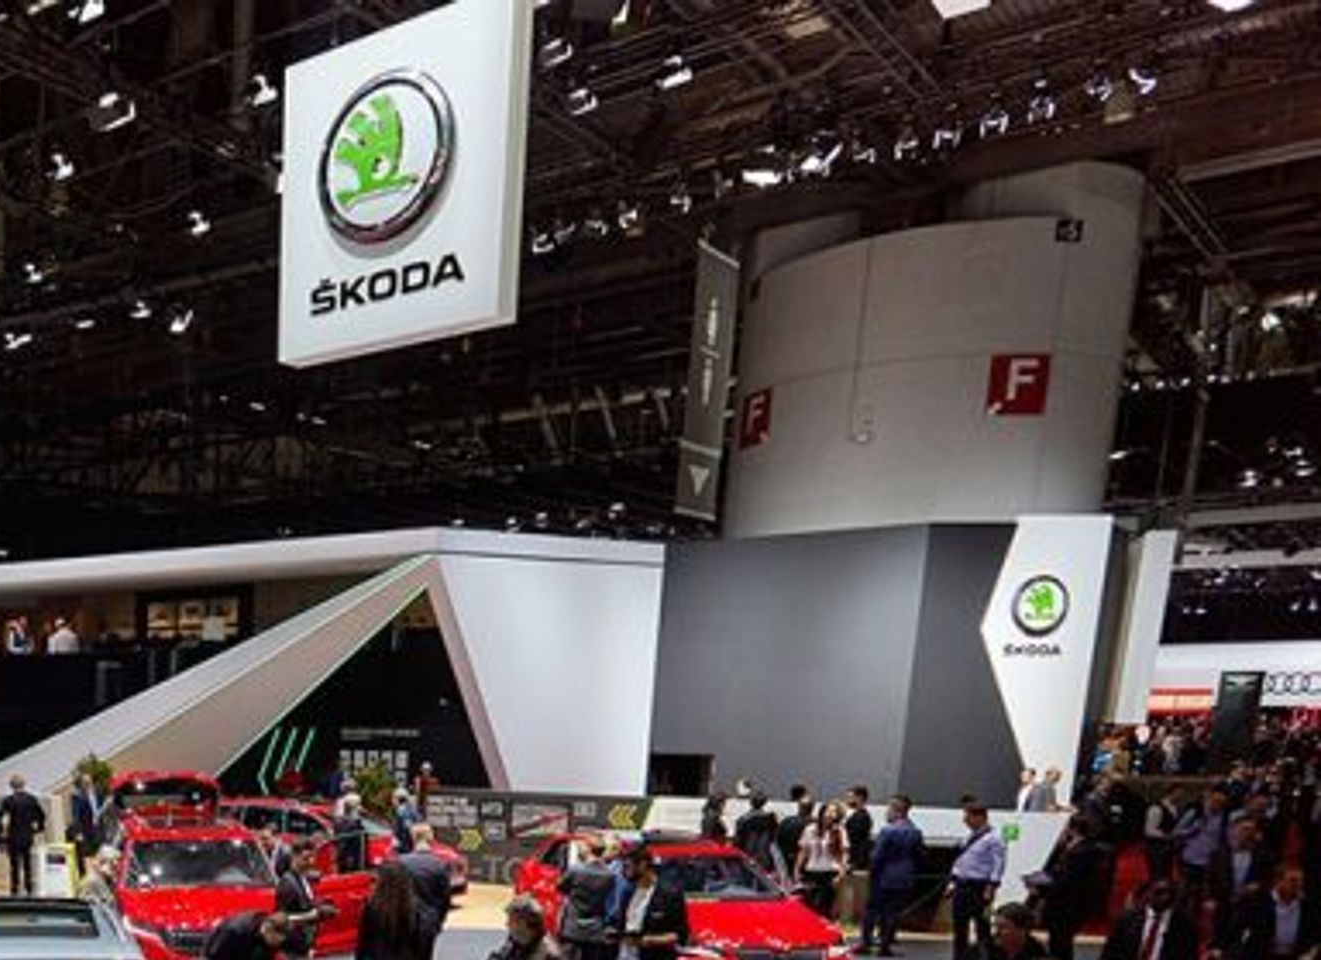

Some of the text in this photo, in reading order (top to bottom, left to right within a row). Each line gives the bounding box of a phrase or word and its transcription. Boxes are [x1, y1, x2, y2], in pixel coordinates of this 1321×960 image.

[310, 252, 465, 317] ŠKODA
[1006, 358, 1040, 401] F
[746, 395, 765, 436] F
